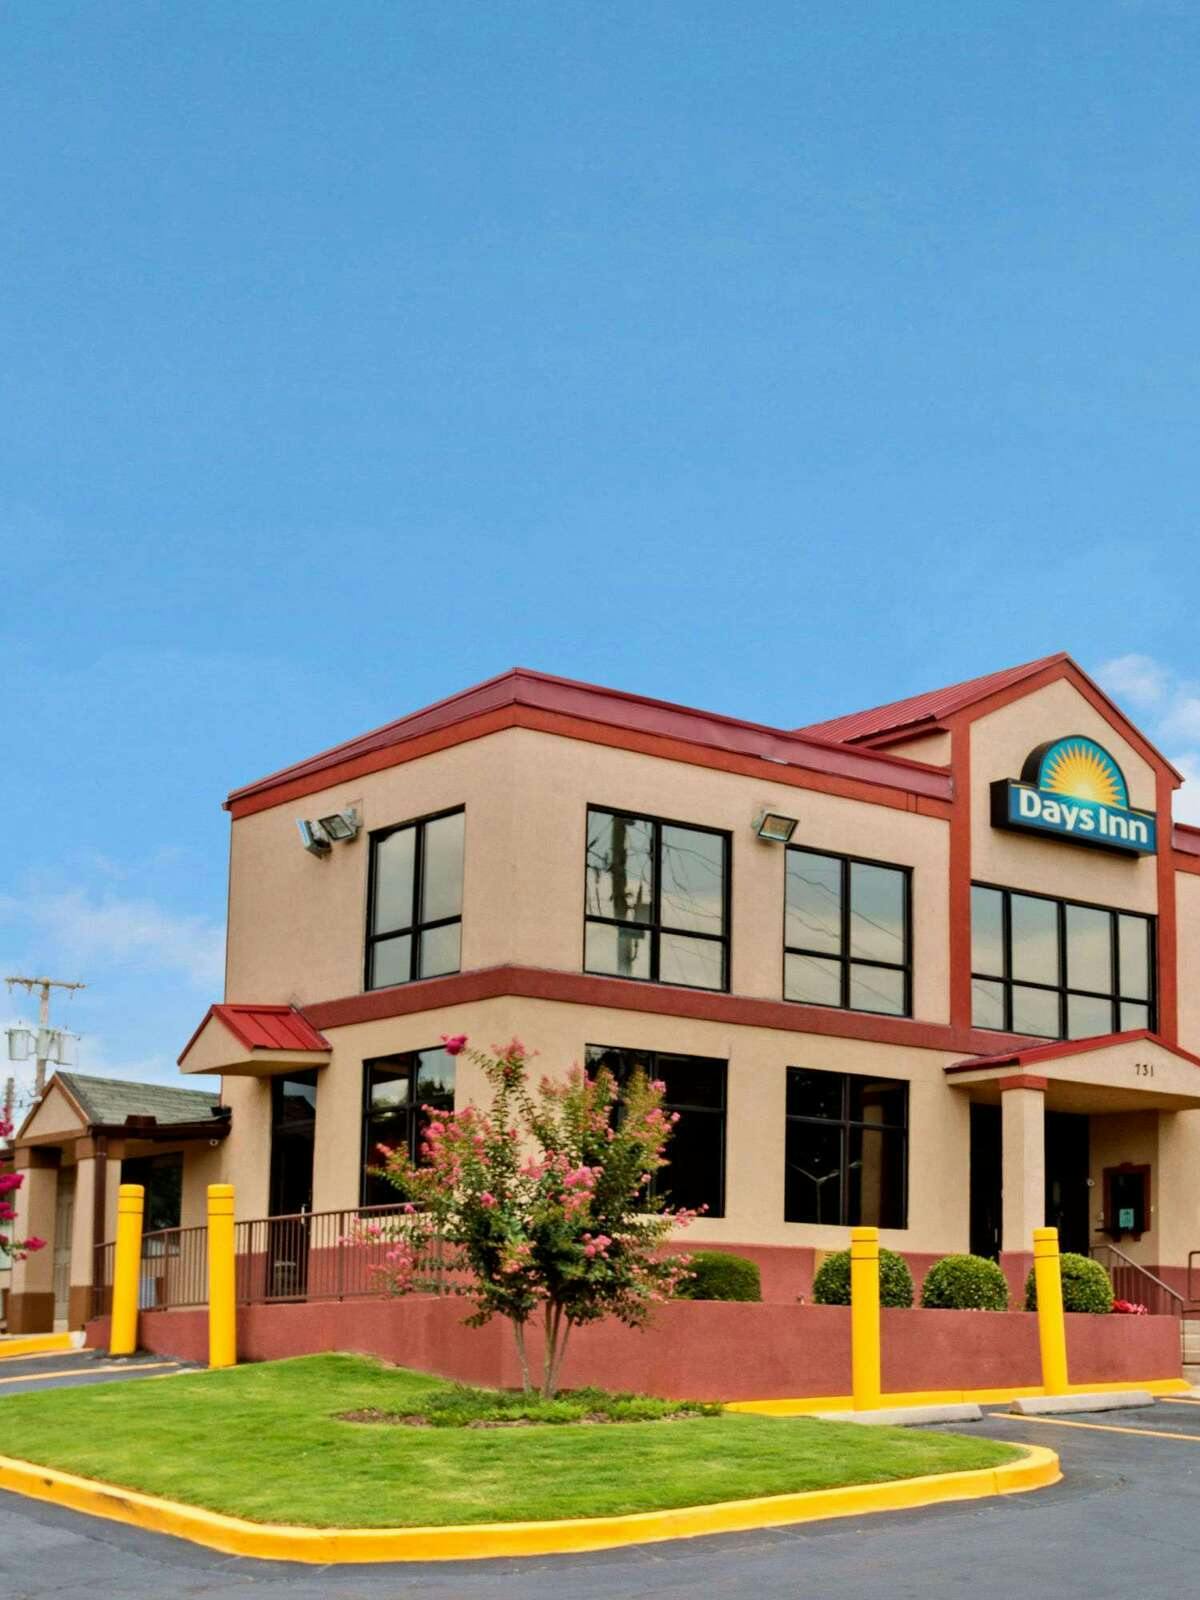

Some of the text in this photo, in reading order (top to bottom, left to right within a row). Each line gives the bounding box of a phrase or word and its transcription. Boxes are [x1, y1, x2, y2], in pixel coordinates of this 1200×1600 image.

[1019, 788, 1148, 843] Days Inn
[1135, 1063, 1154, 1077] 731
